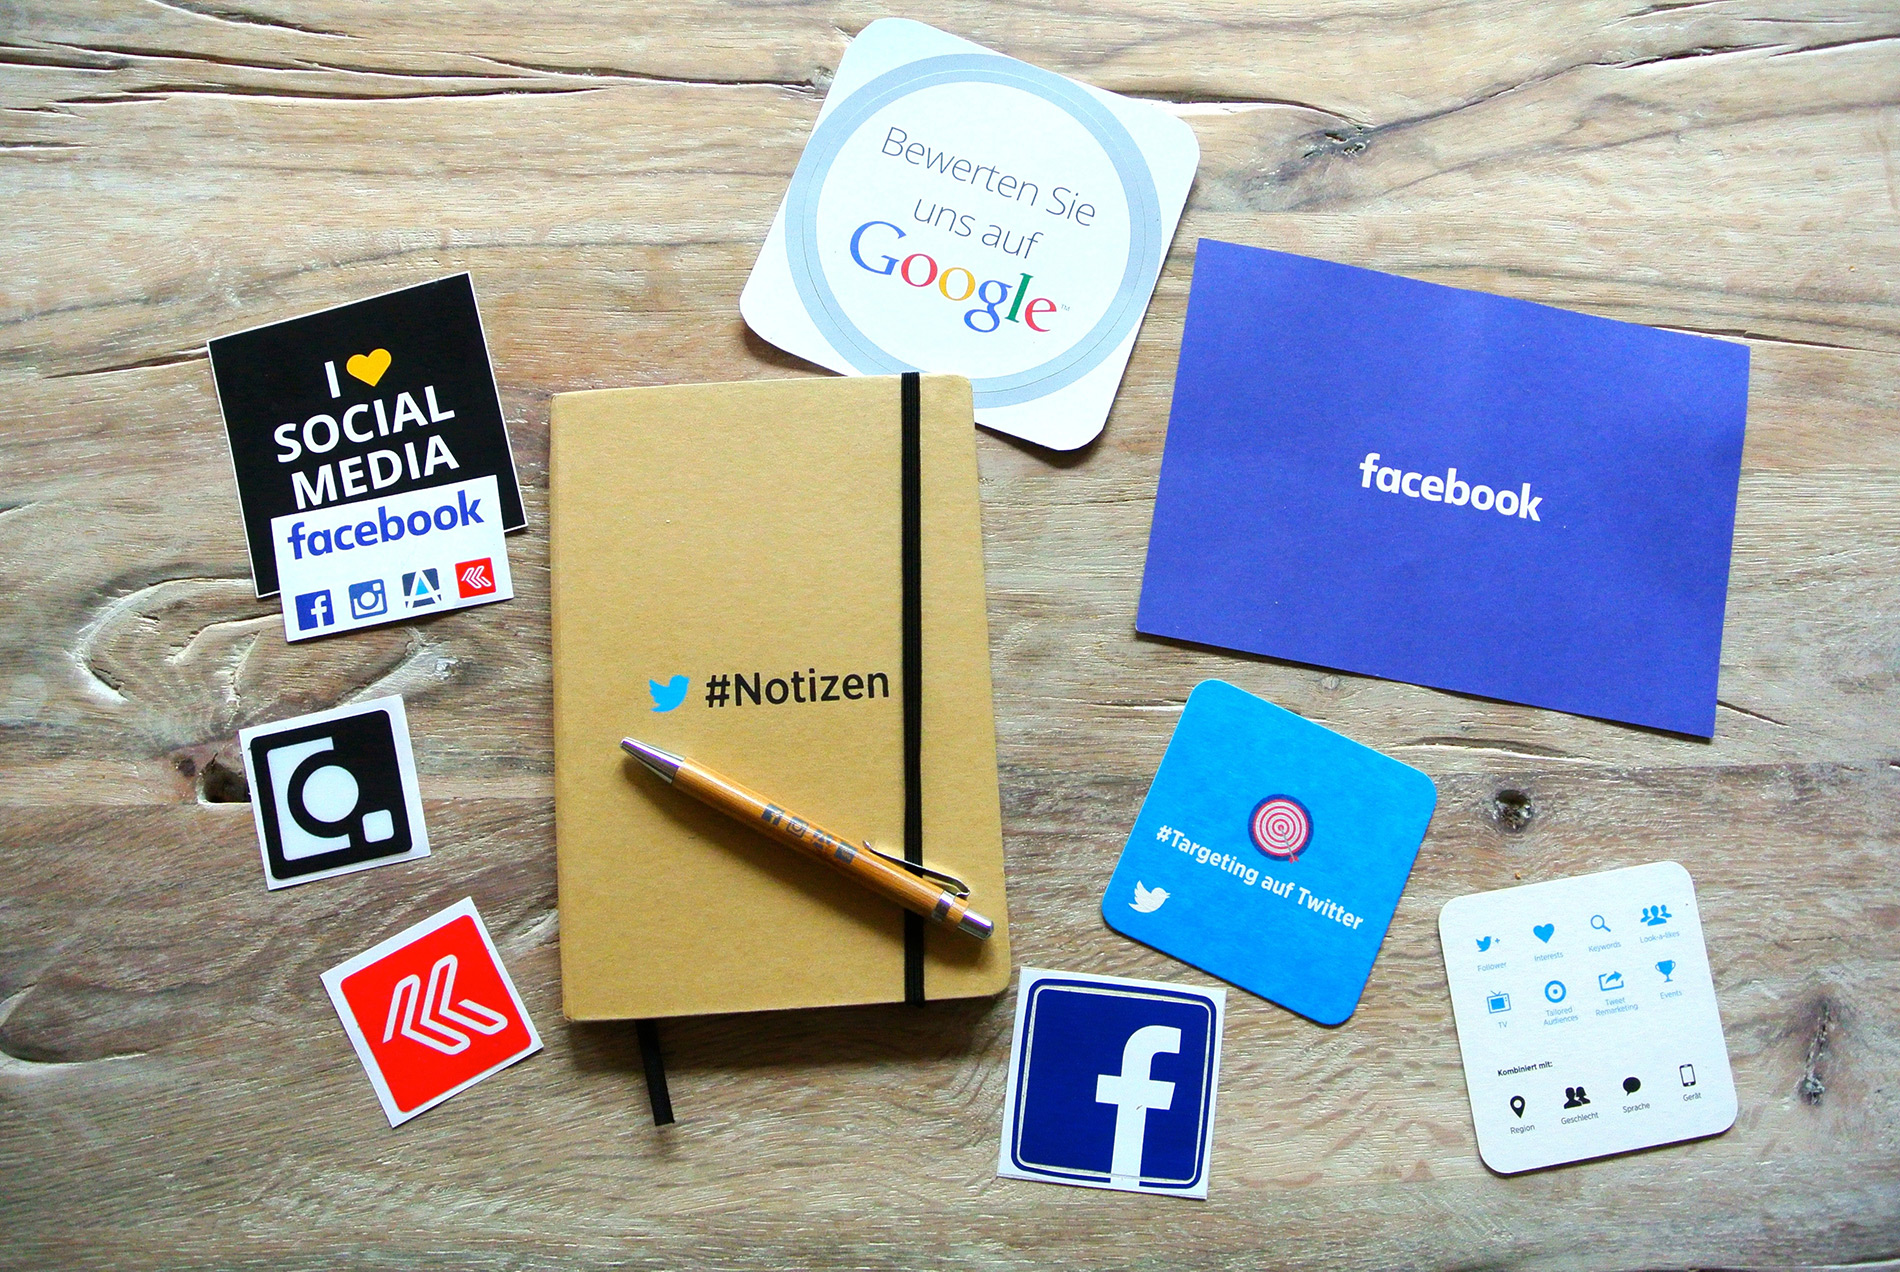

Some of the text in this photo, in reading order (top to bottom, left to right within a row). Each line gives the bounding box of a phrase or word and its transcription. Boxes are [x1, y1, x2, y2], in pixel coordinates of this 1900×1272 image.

[881, 126, 1097, 227] Bewerten Sie
[914, 198, 1044, 259] uns auf
[849, 220, 1058, 333] Google
[324, 360, 341, 399] I
[273, 385, 456, 463] SOCIAL
[291, 434, 460, 510] MEDIA
[1359, 452, 1543, 522] facebook
[287, 489, 485, 560] facebook
[705, 668, 890, 708] #Notizen
[1156, 824, 1364, 930] #Targeting auf Twitter
[1639, 931, 1680, 943] Look-a-likes
[1588, 941, 1622, 952] Keywords
[1534, 952, 1564, 961] Interests
[1477, 962, 1507, 972] Follower
[1660, 990, 1683, 999] Events
[1605, 997, 1626, 1006] Tweet
[1546, 1006, 1573, 1016] Tailored
[1595, 1003, 1639, 1016] Remarketing
[1543, 1015, 1579, 1026] Audiences
[1497, 1061, 1553, 1077] Kombiniert mit:
[1622, 1103, 1651, 1114] Sprache
[1560, 1112, 1599, 1125] Geschlecht
[1510, 1124, 1536, 1134] Region
